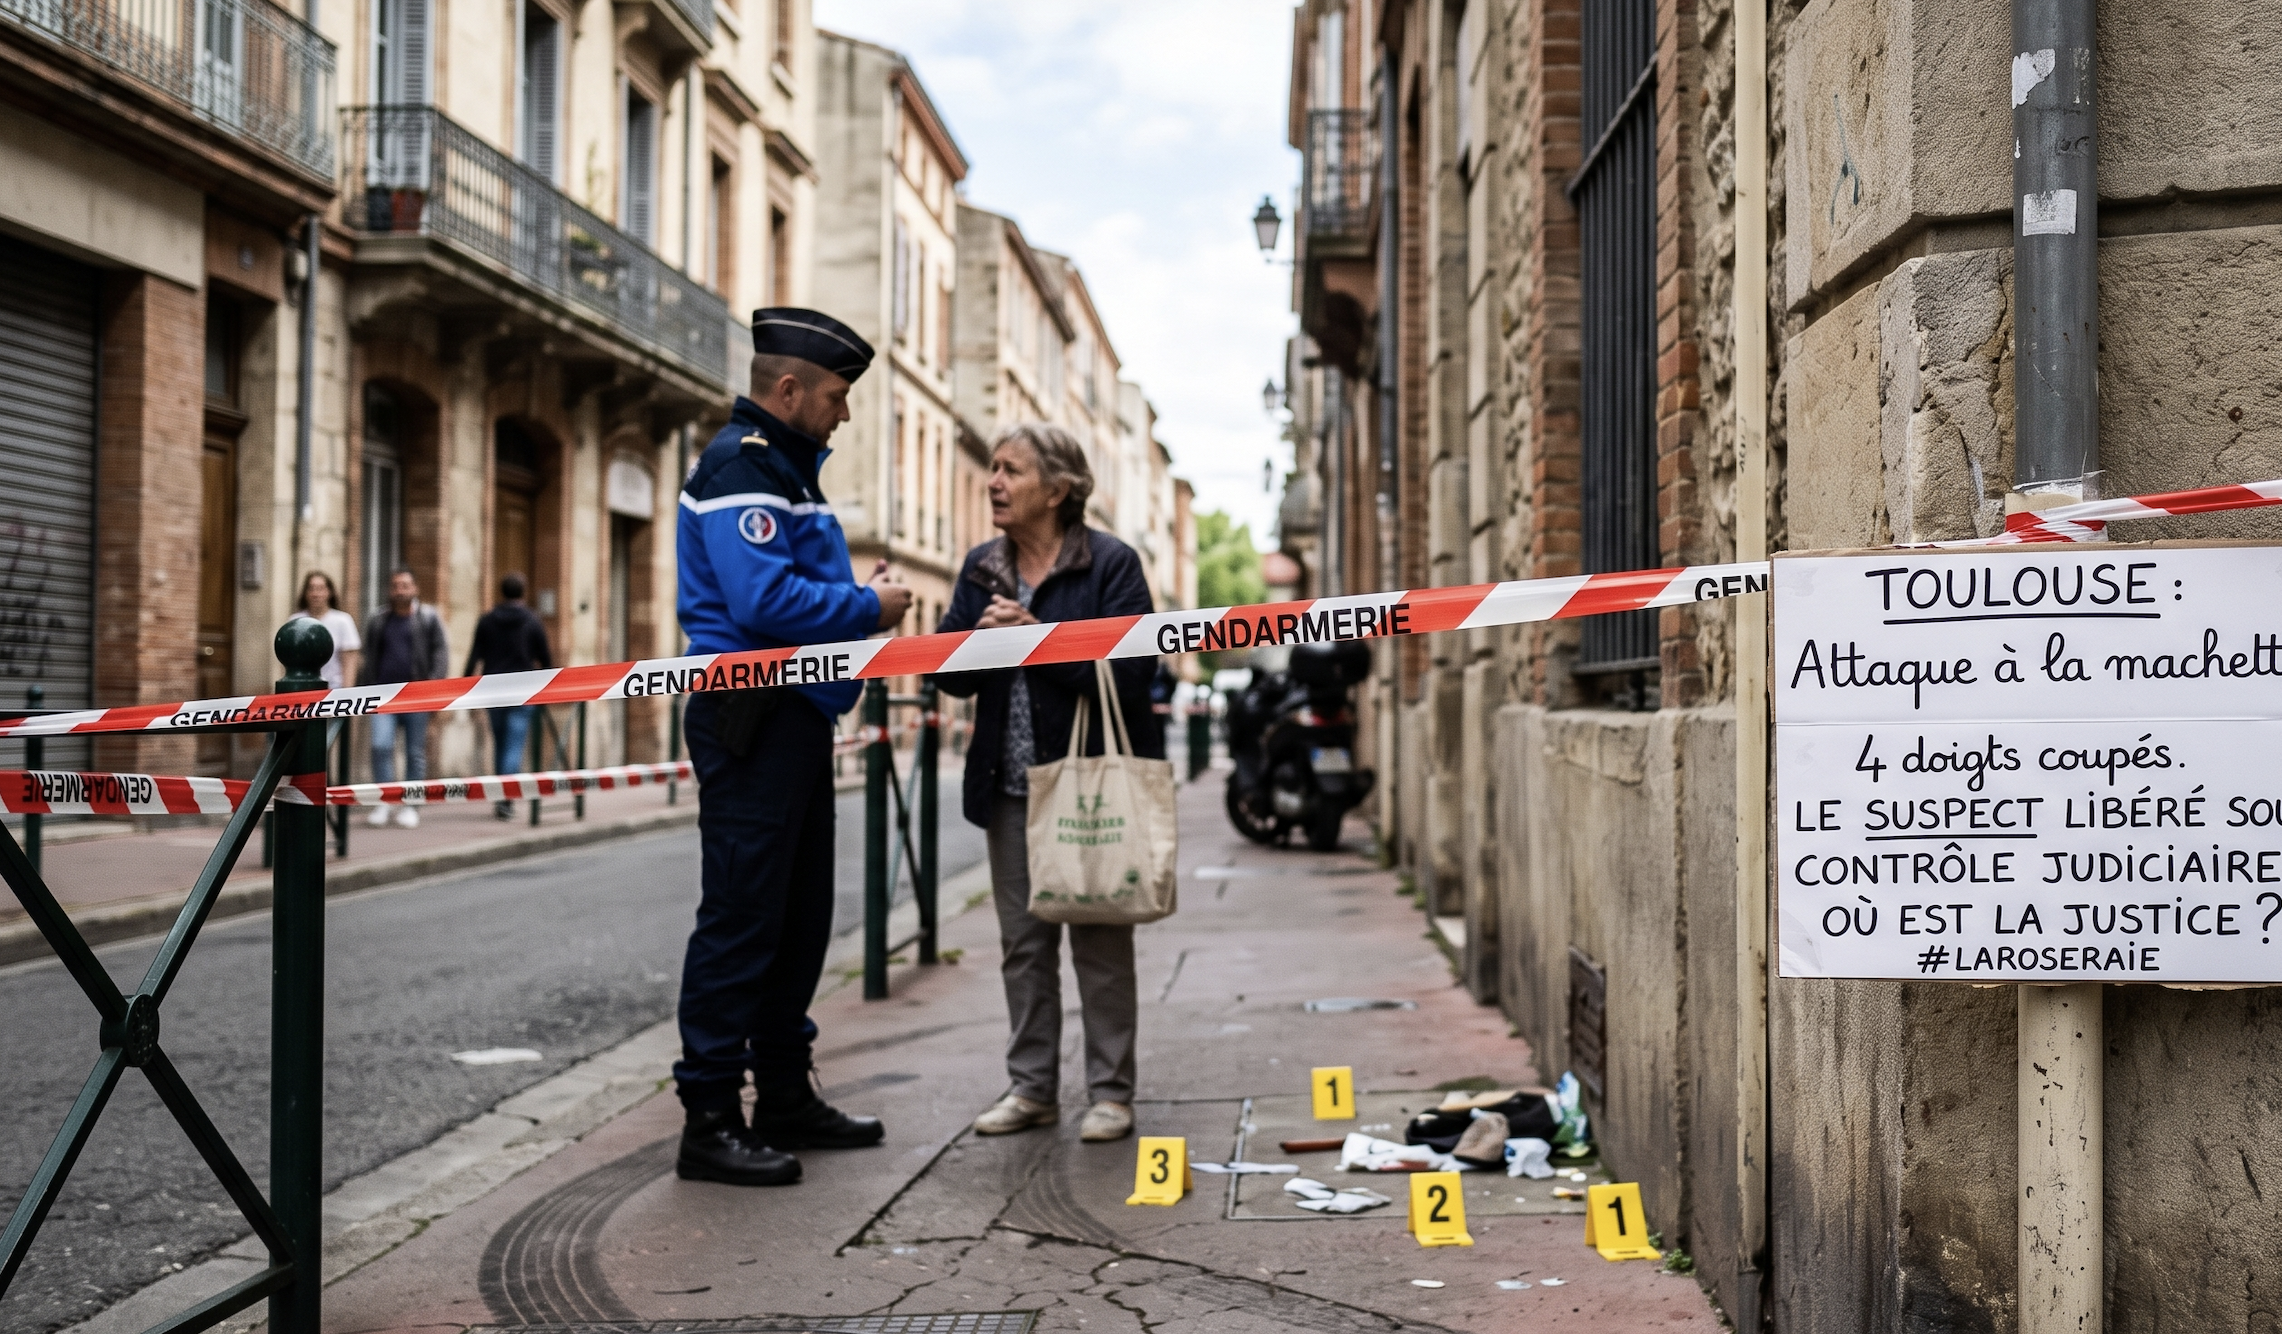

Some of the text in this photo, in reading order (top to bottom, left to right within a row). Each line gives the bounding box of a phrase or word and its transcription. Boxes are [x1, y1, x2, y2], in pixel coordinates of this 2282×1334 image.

[1864, 562, 2157, 611] TOULOUSE
[1157, 603, 1412, 655] GENDARMERIE
[623, 653, 851, 698] GENDARMERIE
[1790, 627, 2282, 710] Attaque à la machett
[1855, 732, 2186, 792] 4 doigts coupés.
[22, 772, 153, 804] GENDARMERIE
[1796, 799, 1842, 832] LE
[1864, 797, 2044, 831] SUSPECT
[1794, 841, 2282, 887] CONTRÔLE JUDICIAIRE
[1822, 894, 1878, 937] OÙ
[1899, 903, 1974, 935] EST
[1995, 903, 2043, 935] LA
[2063, 896, 2241, 936] JUSTICE
[1917, 940, 2160, 974] #LAROSERAIE
[1325, 1076, 1339, 1107] 1
[1150, 1149, 1169, 1184] 3
[1427, 1184, 1450, 1223] 2
[1607, 1196, 1627, 1237] 1
